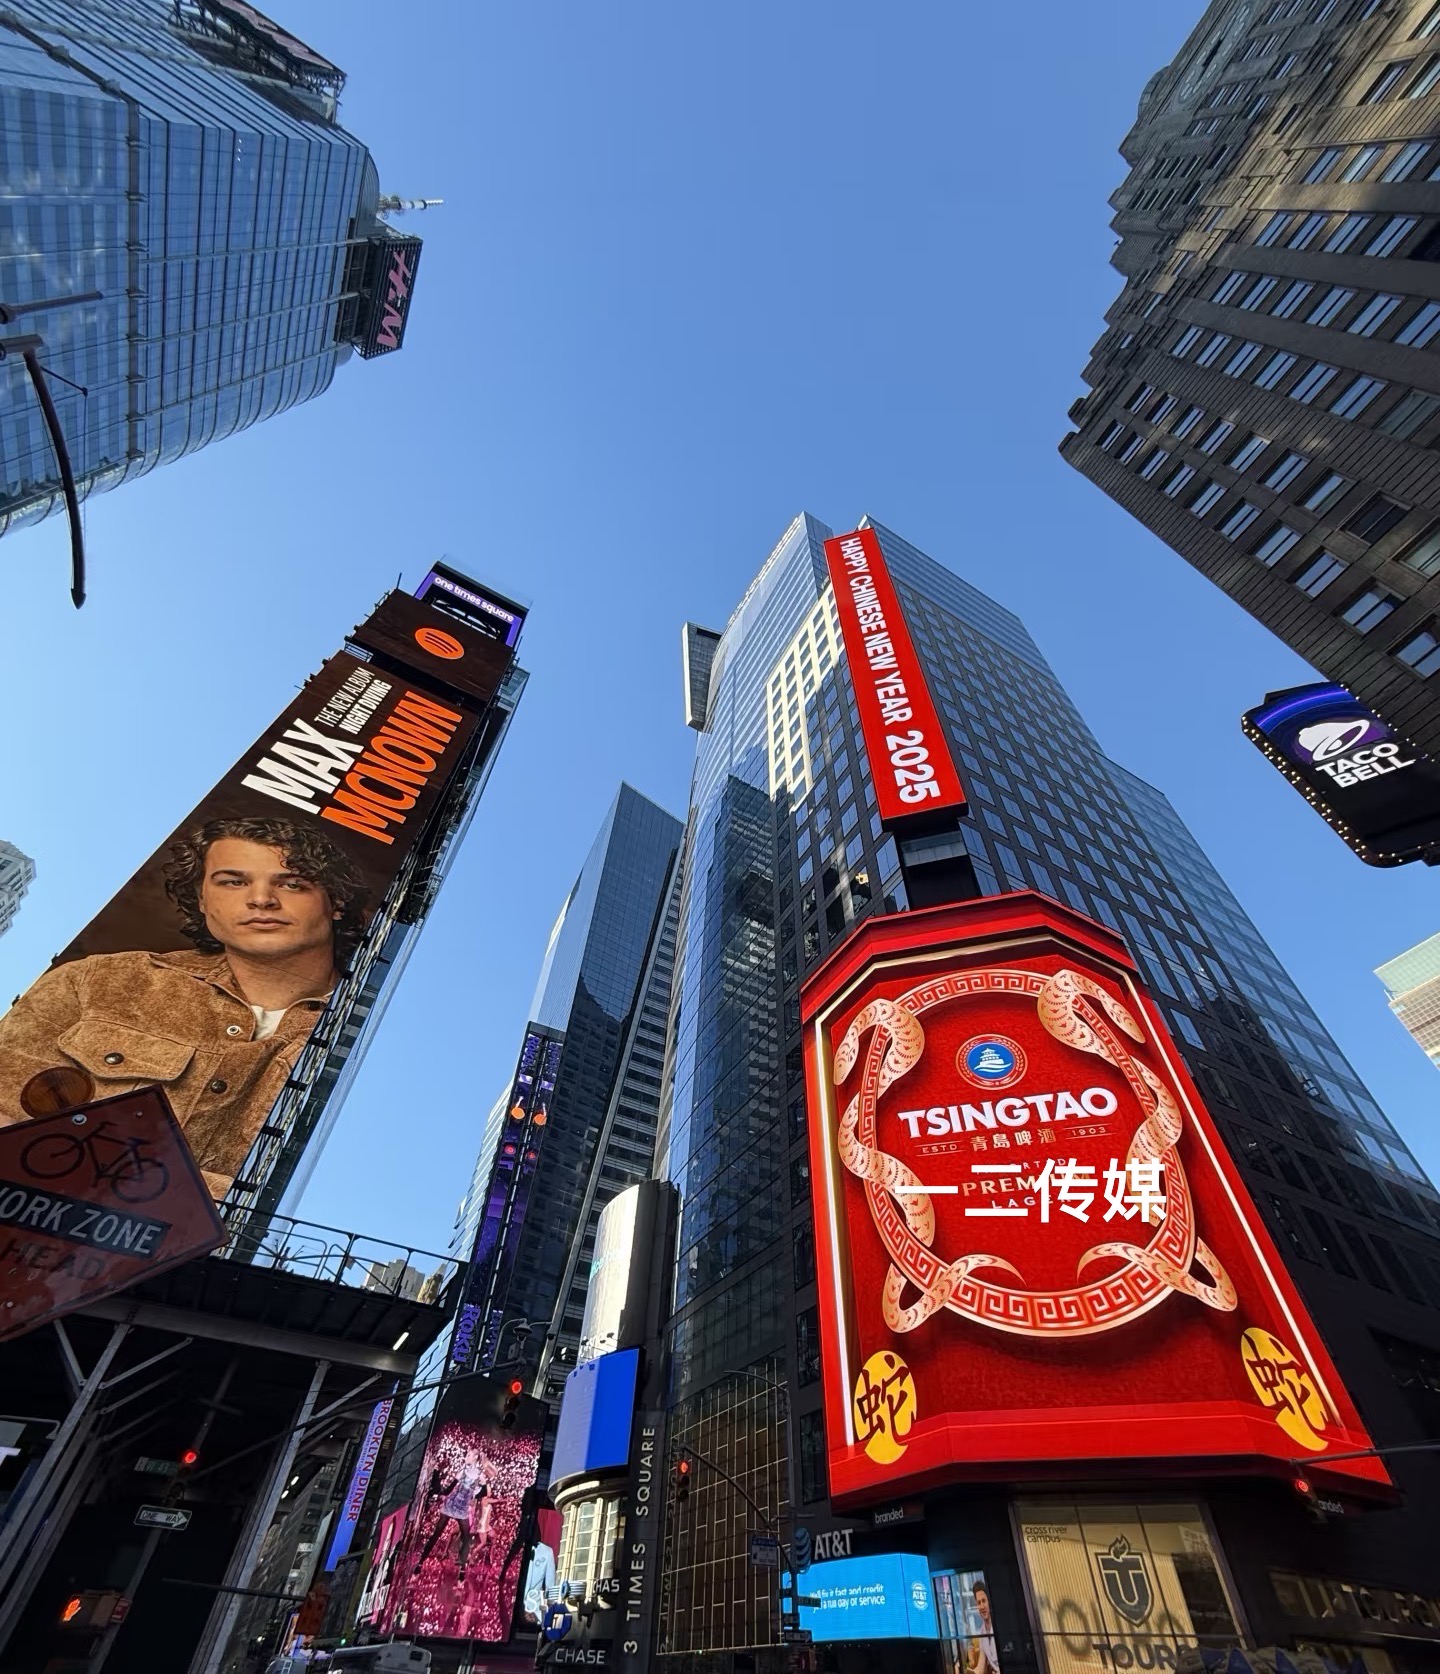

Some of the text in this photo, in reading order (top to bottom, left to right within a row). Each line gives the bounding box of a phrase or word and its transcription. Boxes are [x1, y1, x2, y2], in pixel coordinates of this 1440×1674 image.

[434, 577, 514, 622] one times square
[840, 536, 941, 804] HAPPY CHINESE NEW YEAR 2025
[314, 666, 375, 727] THE NEW ALBUM
[339, 679, 392, 735] NIGHT DIVING
[241, 718, 365, 815] MAX
[320, 690, 463, 845] MCNOWN
[1315, 743, 1399, 776] TACO
[1331, 756, 1416, 788] BELL
[897, 1087, 1118, 1139] TSINGTAO
[970, 1128, 1056, 1152] 青島啤酒
[1071, 1126, 1106, 1137] 1903
[922, 1143, 958, 1154] ESTD
[68, 1208, 162, 1255] ZONE
[452, 1304, 481, 1364] ROKU
[347, 1399, 392, 1522] BROOKLYN DINER
[142, 1511, 183, 1523] ONE WAY
[875, 1507, 904, 1524] branded
[1025, 1526, 1067, 1535] cross river
[623, 1427, 655, 1655] 3 TIMES SQUARE
[814, 1528, 854, 1560] AT&T
[1027, 1534, 1061, 1545] campus
[859, 1594, 886, 1606] service
[555, 1648, 606, 1665] CHASE
